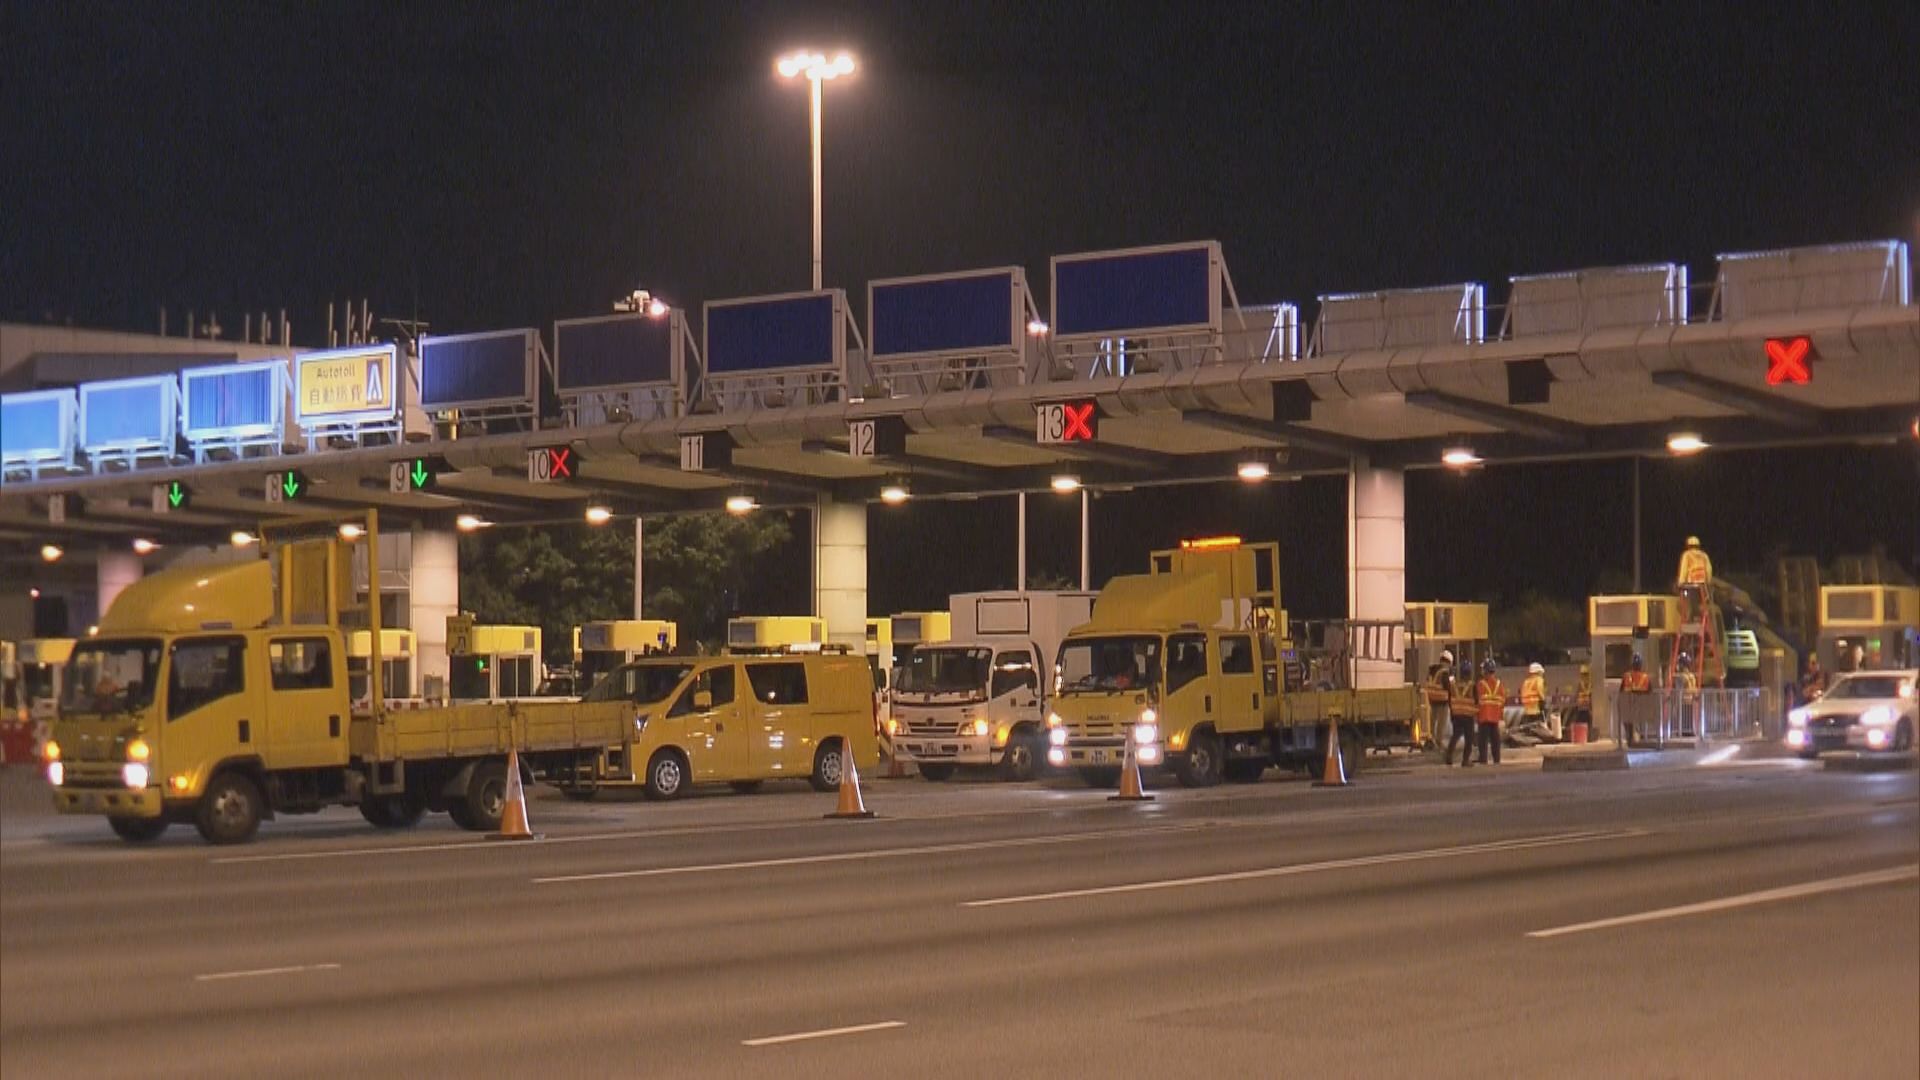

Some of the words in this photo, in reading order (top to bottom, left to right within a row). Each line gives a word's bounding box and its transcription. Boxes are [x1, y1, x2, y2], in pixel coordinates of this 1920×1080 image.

[316, 364, 356, 379] Autotoll
[1040, 406, 1063, 441] 13
[687, 438, 701, 468] 11
[854, 424, 873, 457] 12
[396, 463, 406, 491] 9
[531, 452, 549, 480] 10
[270, 475, 280, 501] 8
